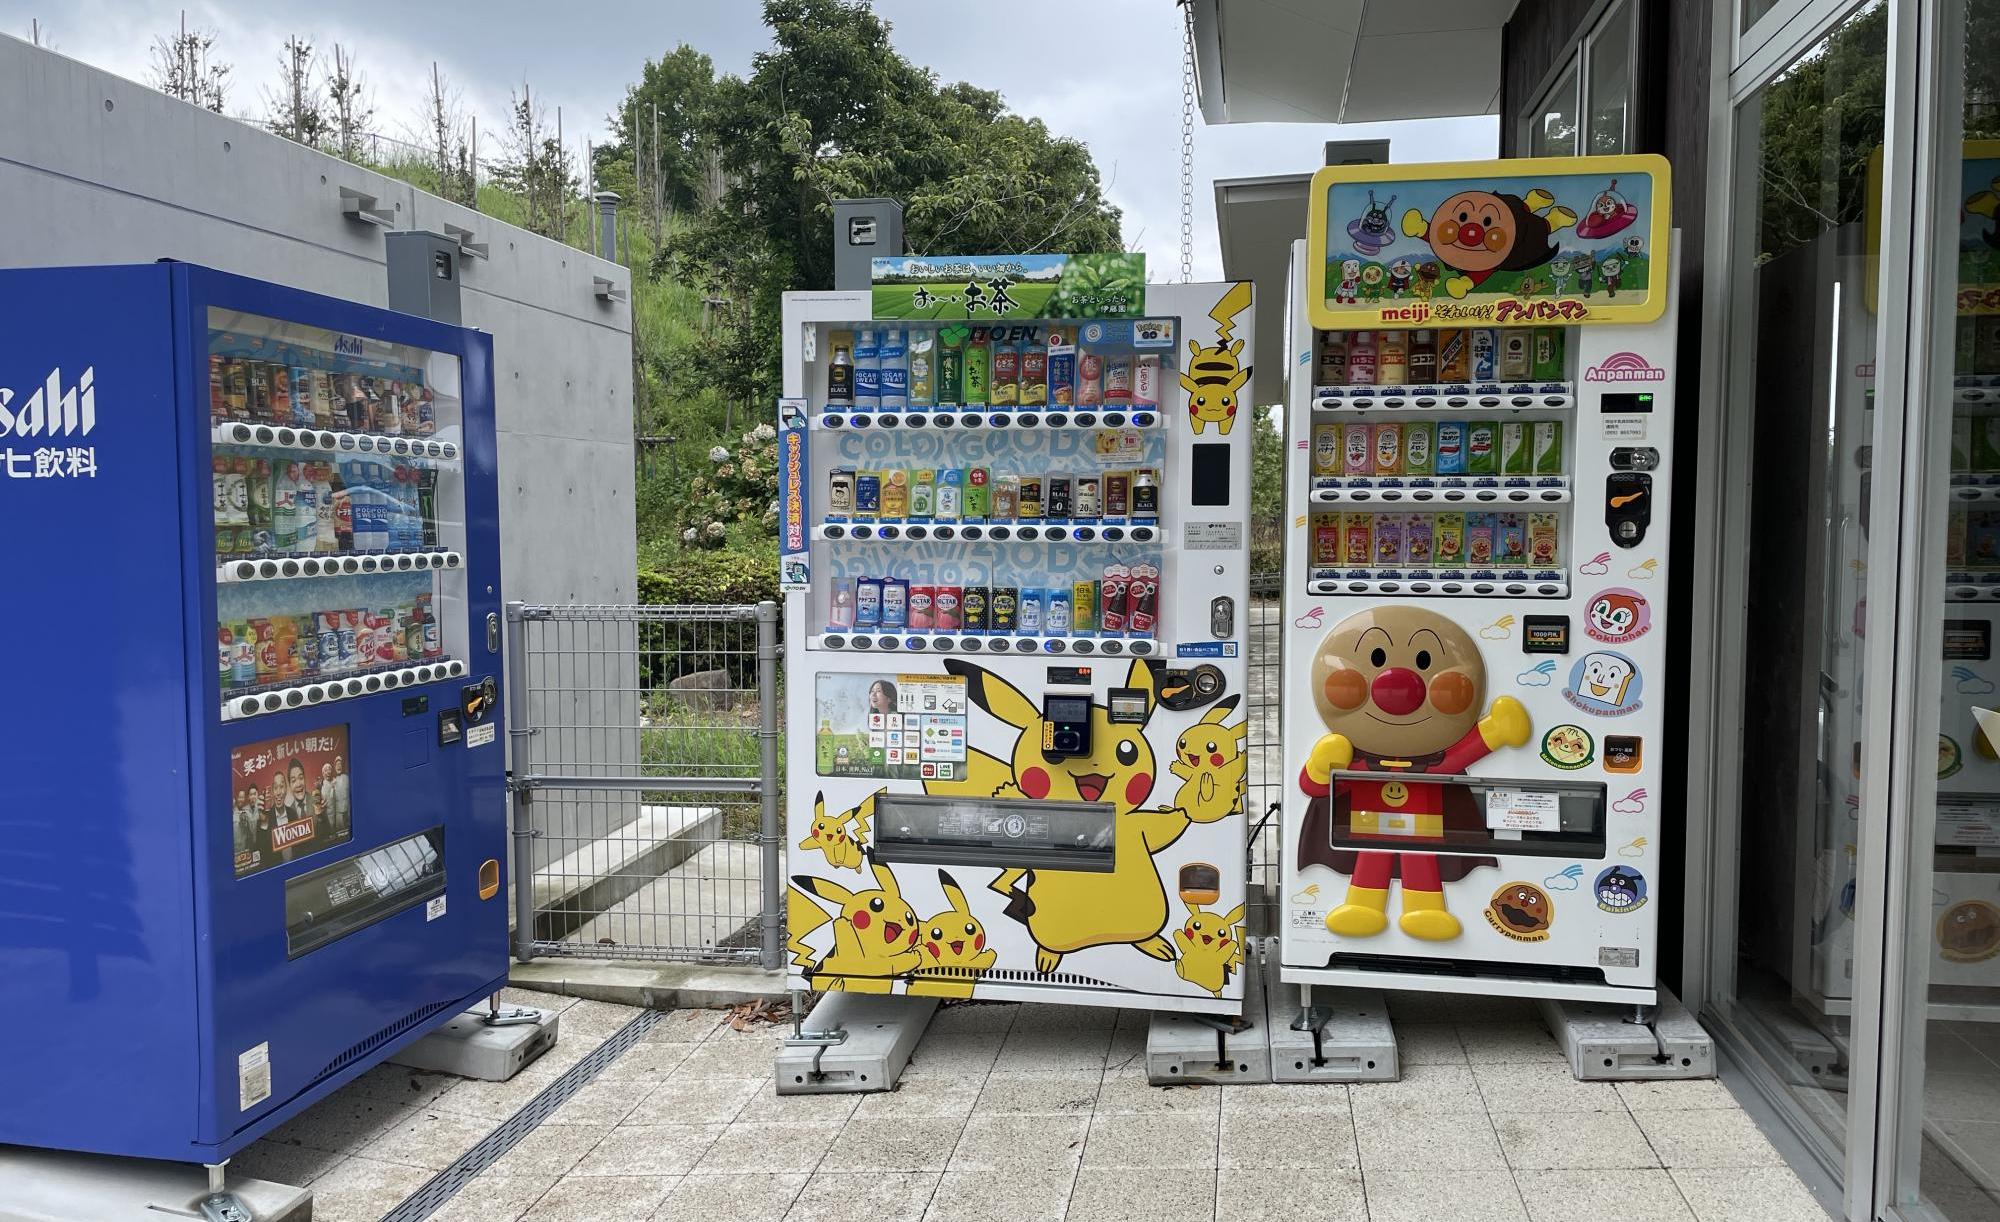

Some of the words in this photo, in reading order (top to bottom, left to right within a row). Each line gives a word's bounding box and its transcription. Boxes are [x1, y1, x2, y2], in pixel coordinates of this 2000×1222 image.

[1382, 304, 1429, 323] meiji
[1496, 300, 1588, 322] アンパンマン
[970, 326, 1007, 341] ITO
[1008, 326, 1038, 341] EN
[335, 335, 362, 356] Asahi
[1585, 367, 1665, 382] Anpanman
[0, 447, 97, 478] ヒ飲料
[1587, 626, 1649, 643] Dokinchan
[1564, 690, 1640, 715] Shokupanman
[274, 822, 311, 845] WONDA
[1484, 910, 1545, 942] Currypanman
